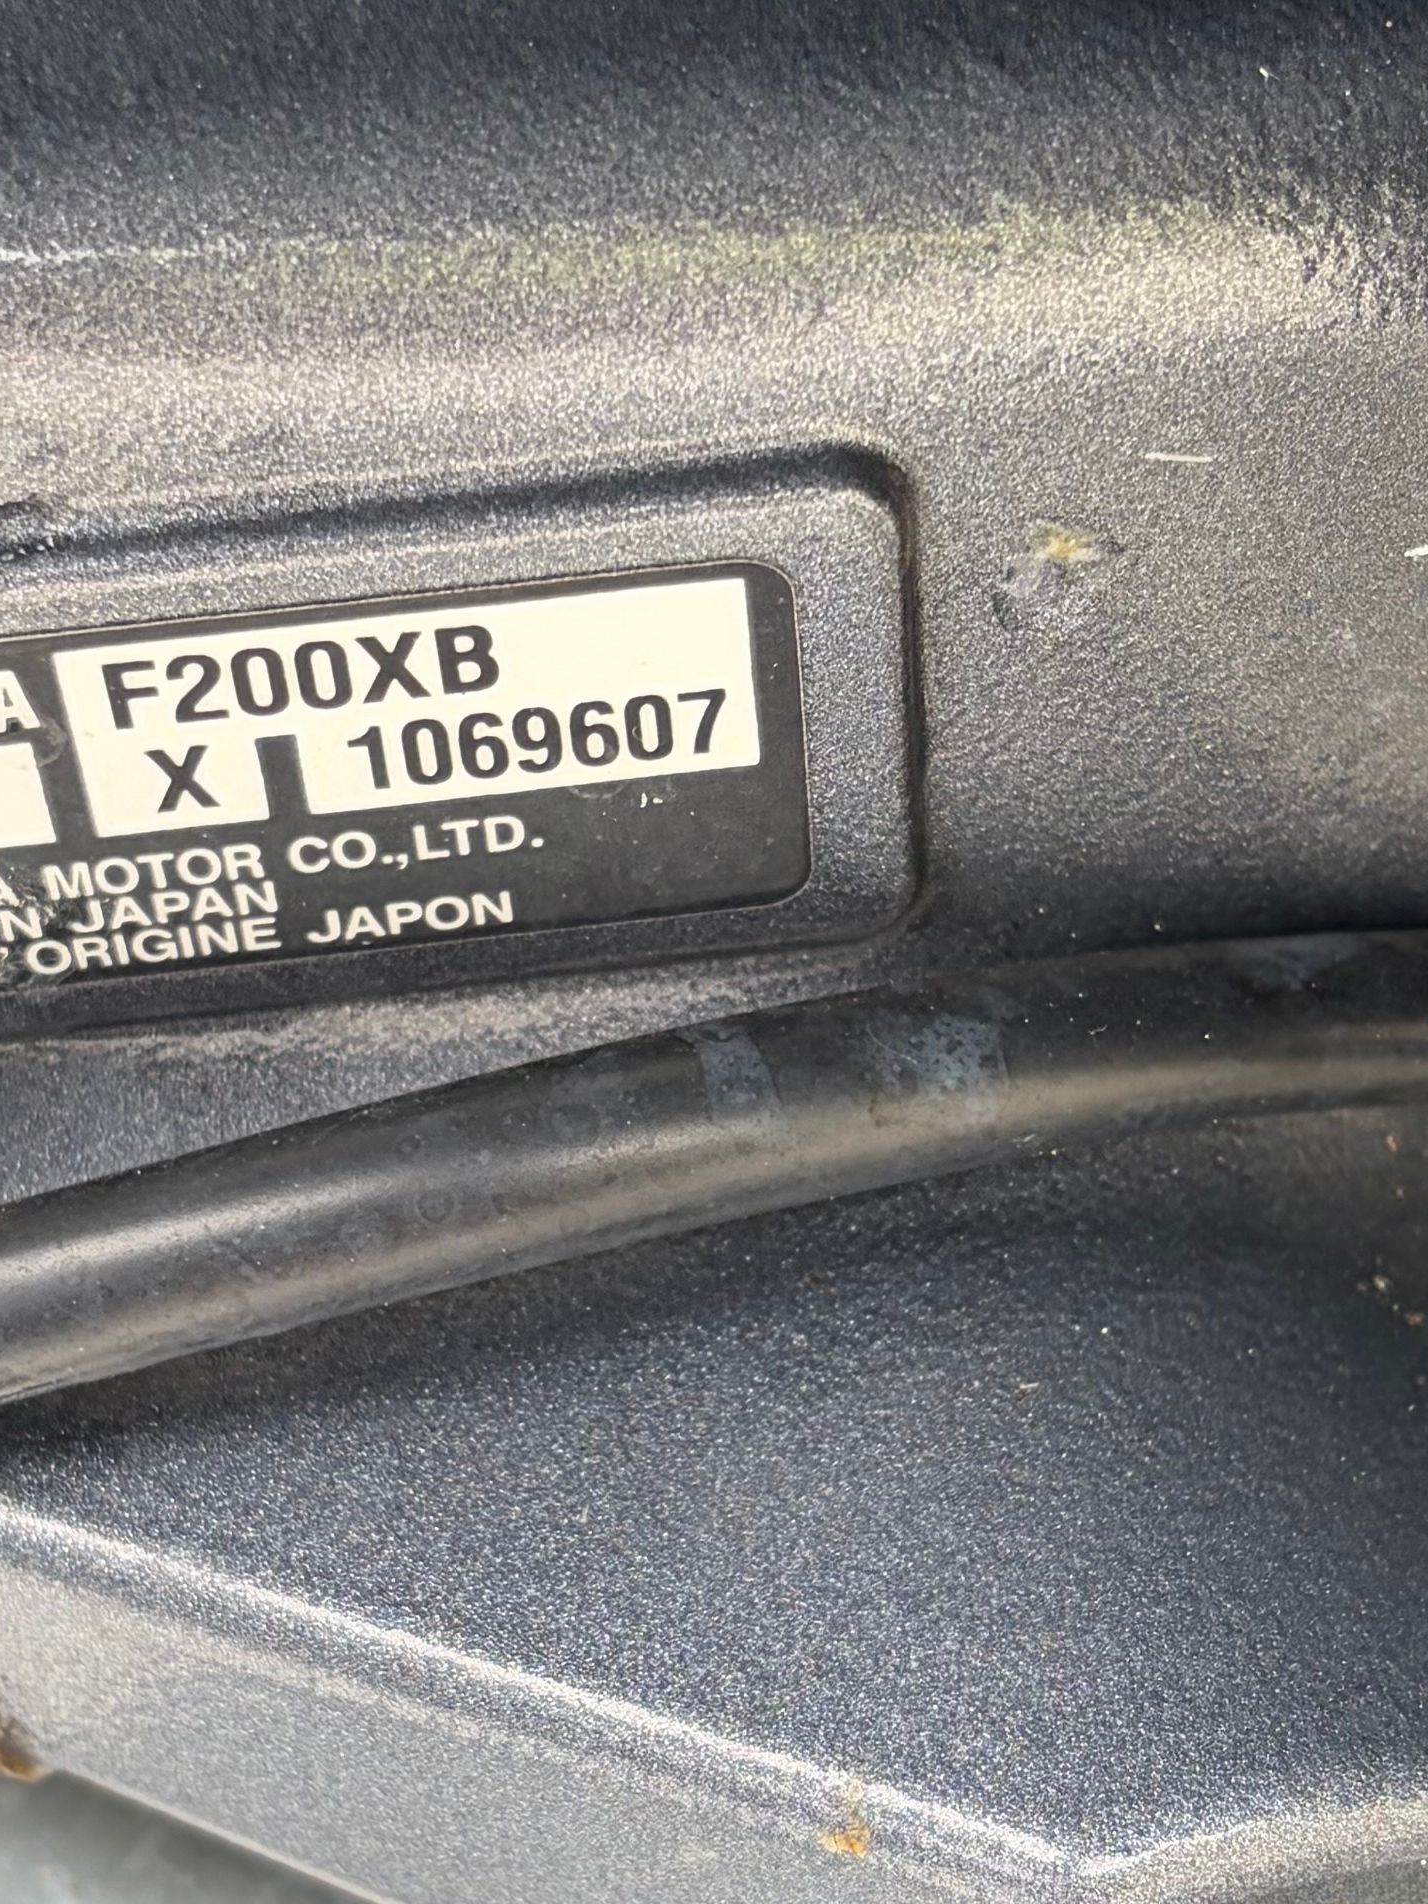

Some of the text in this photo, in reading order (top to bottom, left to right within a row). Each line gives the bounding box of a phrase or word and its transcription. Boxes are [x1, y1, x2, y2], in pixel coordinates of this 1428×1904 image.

[101, 624, 501, 730] F200XB
[144, 688, 728, 814] X 1069607
[42, 842, 266, 902] MOTOR
[67, 880, 279, 934] JAPAN
[305, 889, 515, 945] JAPON
